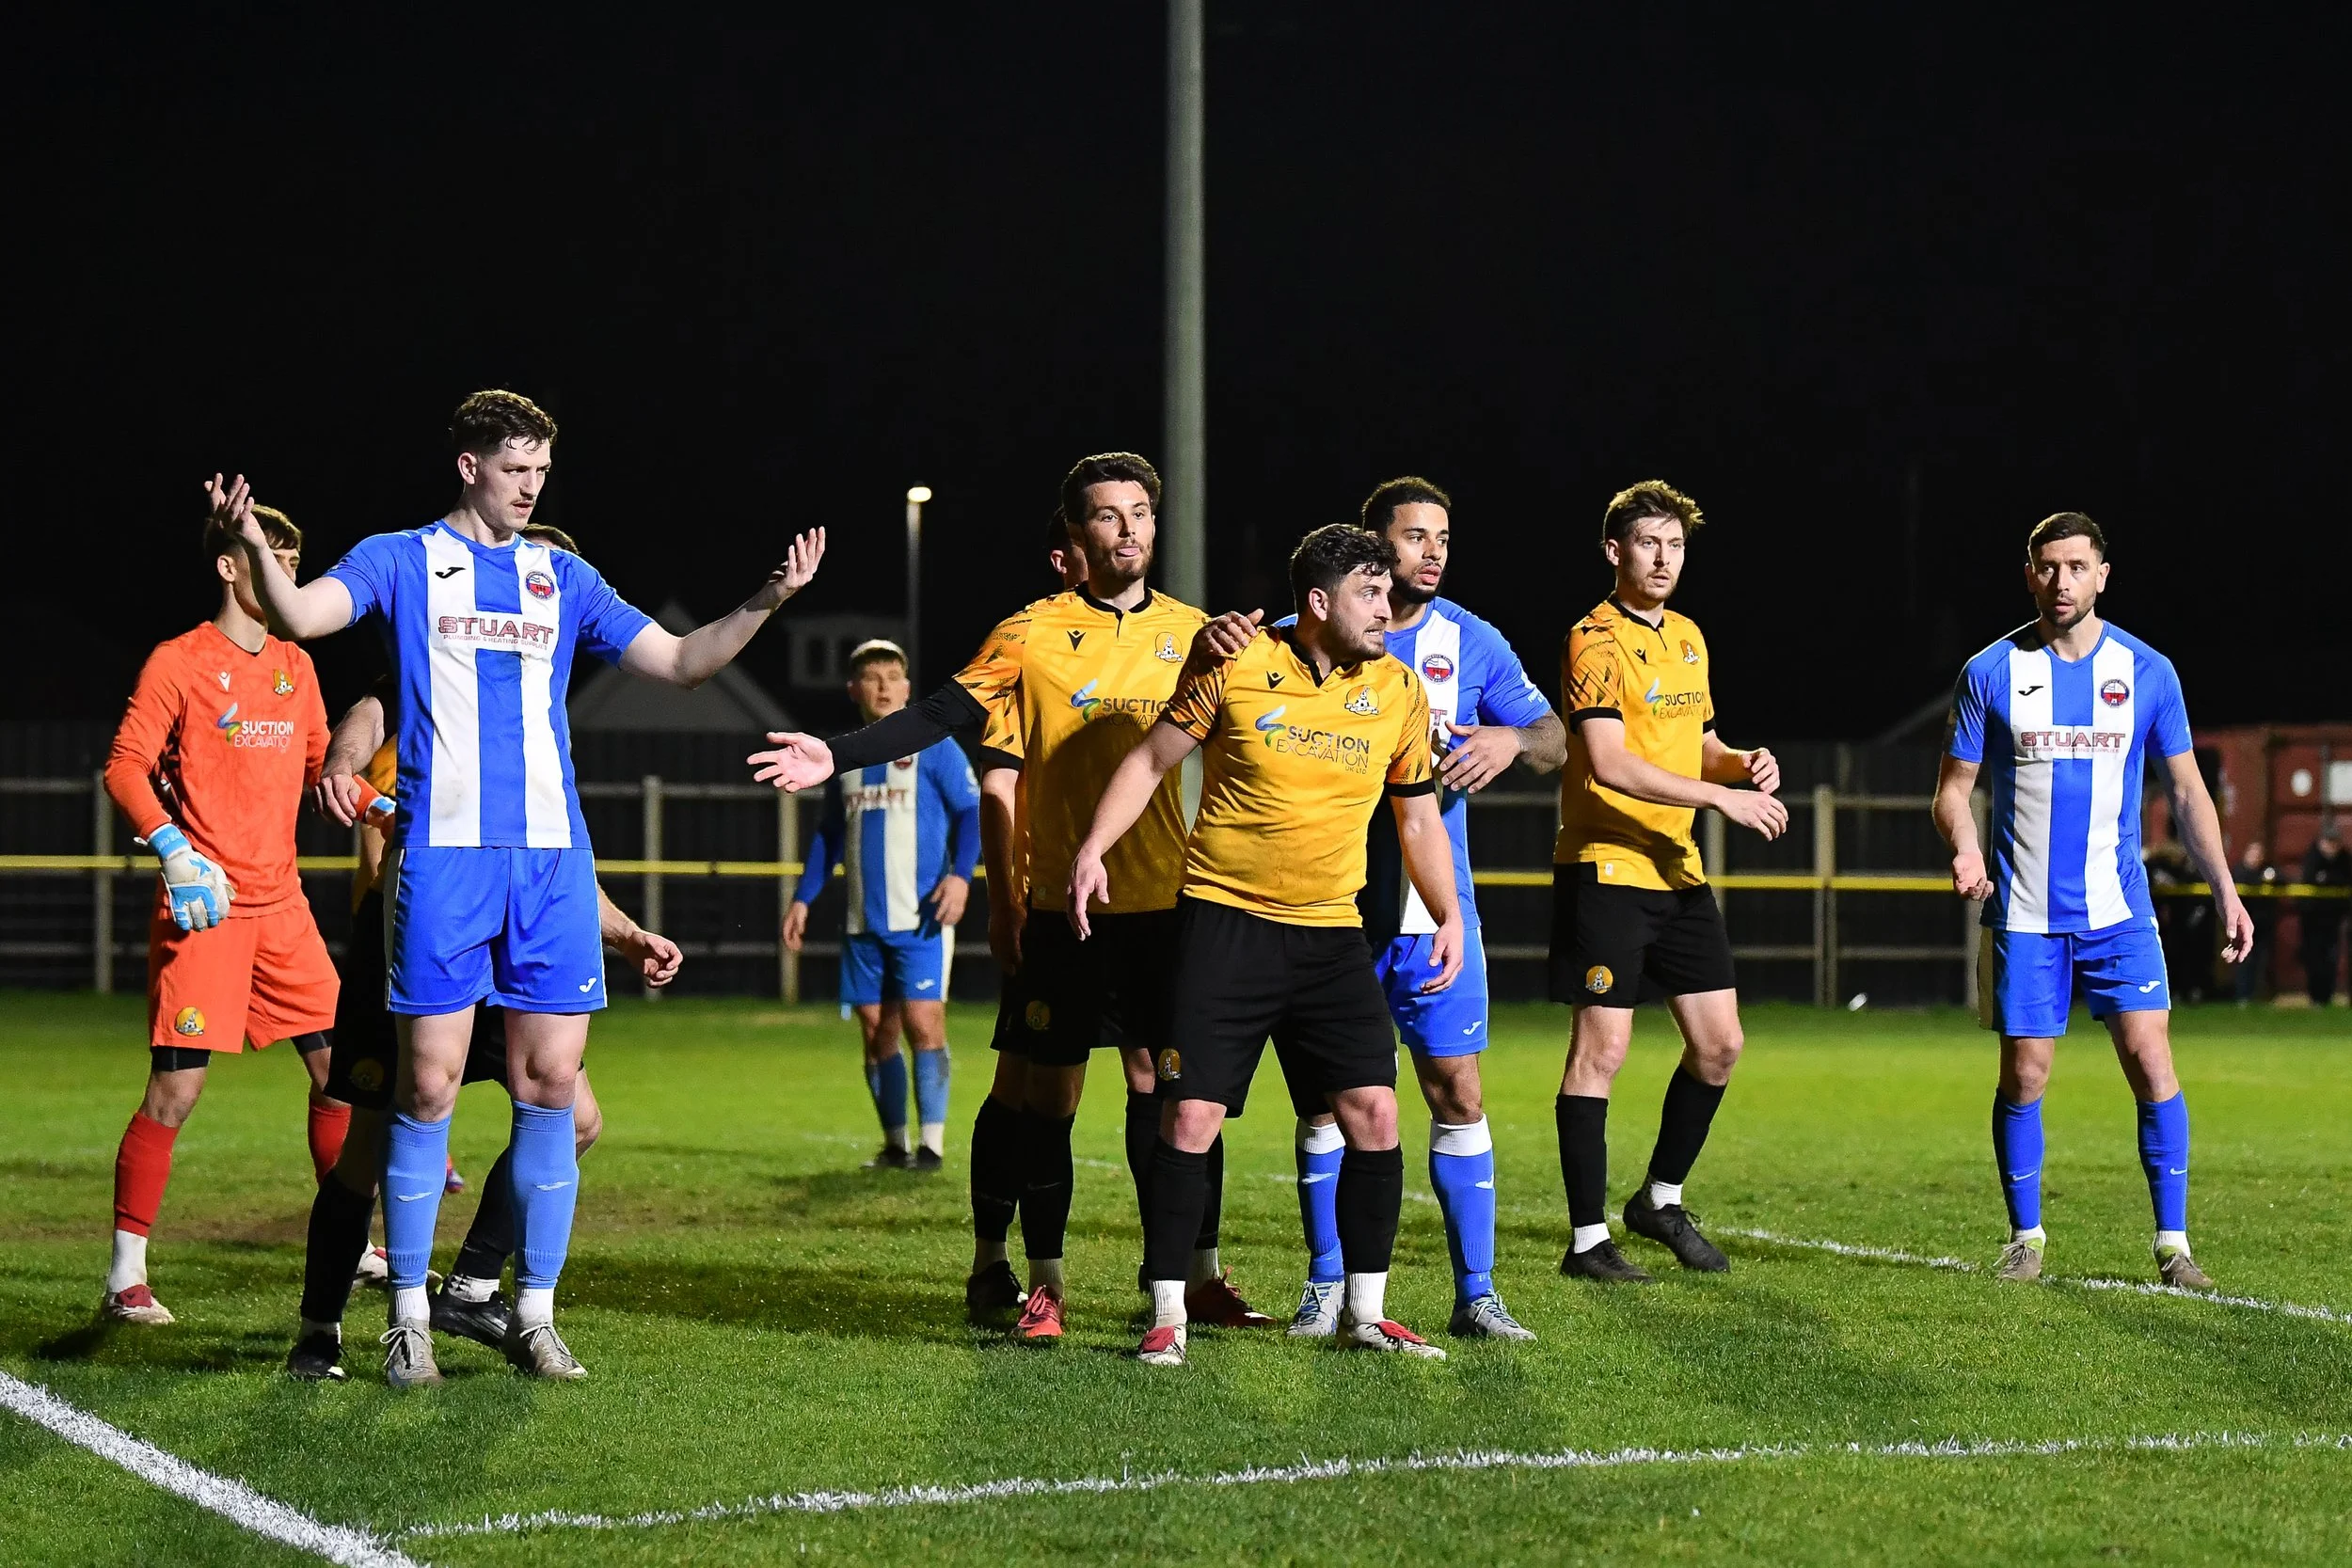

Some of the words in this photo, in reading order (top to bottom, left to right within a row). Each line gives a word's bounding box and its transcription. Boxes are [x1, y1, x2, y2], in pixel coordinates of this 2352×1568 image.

[437, 615, 554, 645] STUART
[520, 640, 548, 651] SUPPLIES
[1102, 697, 1168, 714] SUCTIO
[241, 720, 294, 736] SUCTION
[233, 734, 291, 749] EXCAVATIO
[1287, 725, 1370, 754] SUCTION
[2020, 731, 2126, 749] STUART
[1276, 738, 1369, 768] EXCAVATION
